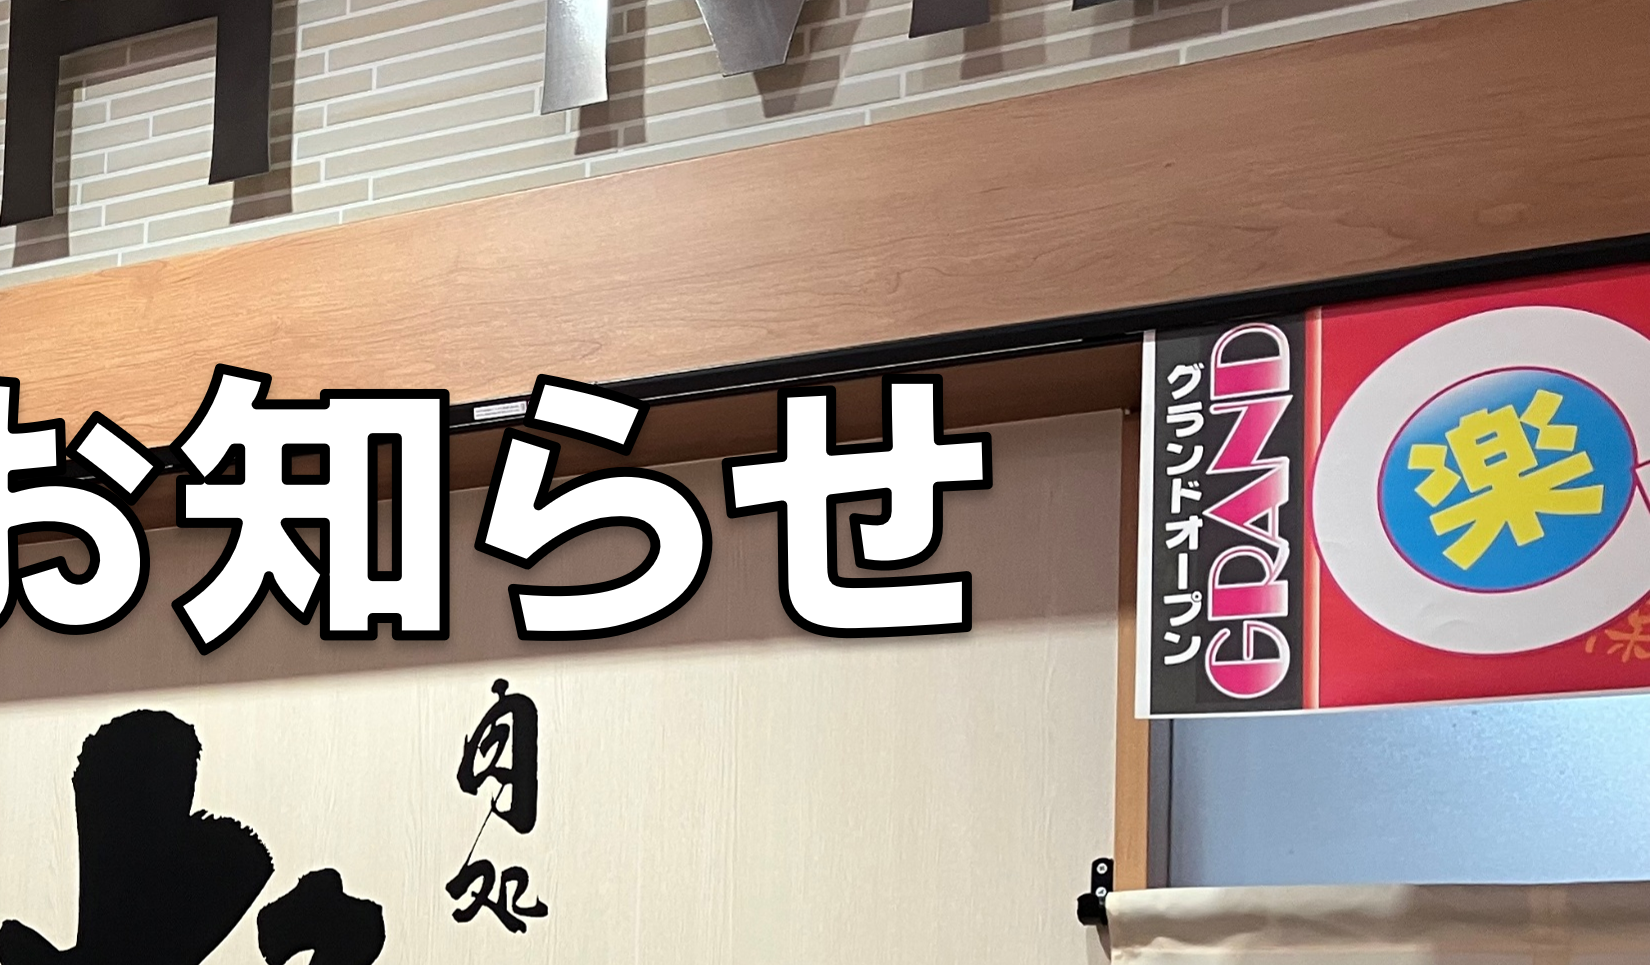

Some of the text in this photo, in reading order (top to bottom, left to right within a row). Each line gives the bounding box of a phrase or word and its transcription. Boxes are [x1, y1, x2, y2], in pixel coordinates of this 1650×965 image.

[1163, 361, 1205, 665] グランドオープン
[1203, 322, 1293, 699] GRAND
[1408, 388, 1604, 571] 楽
